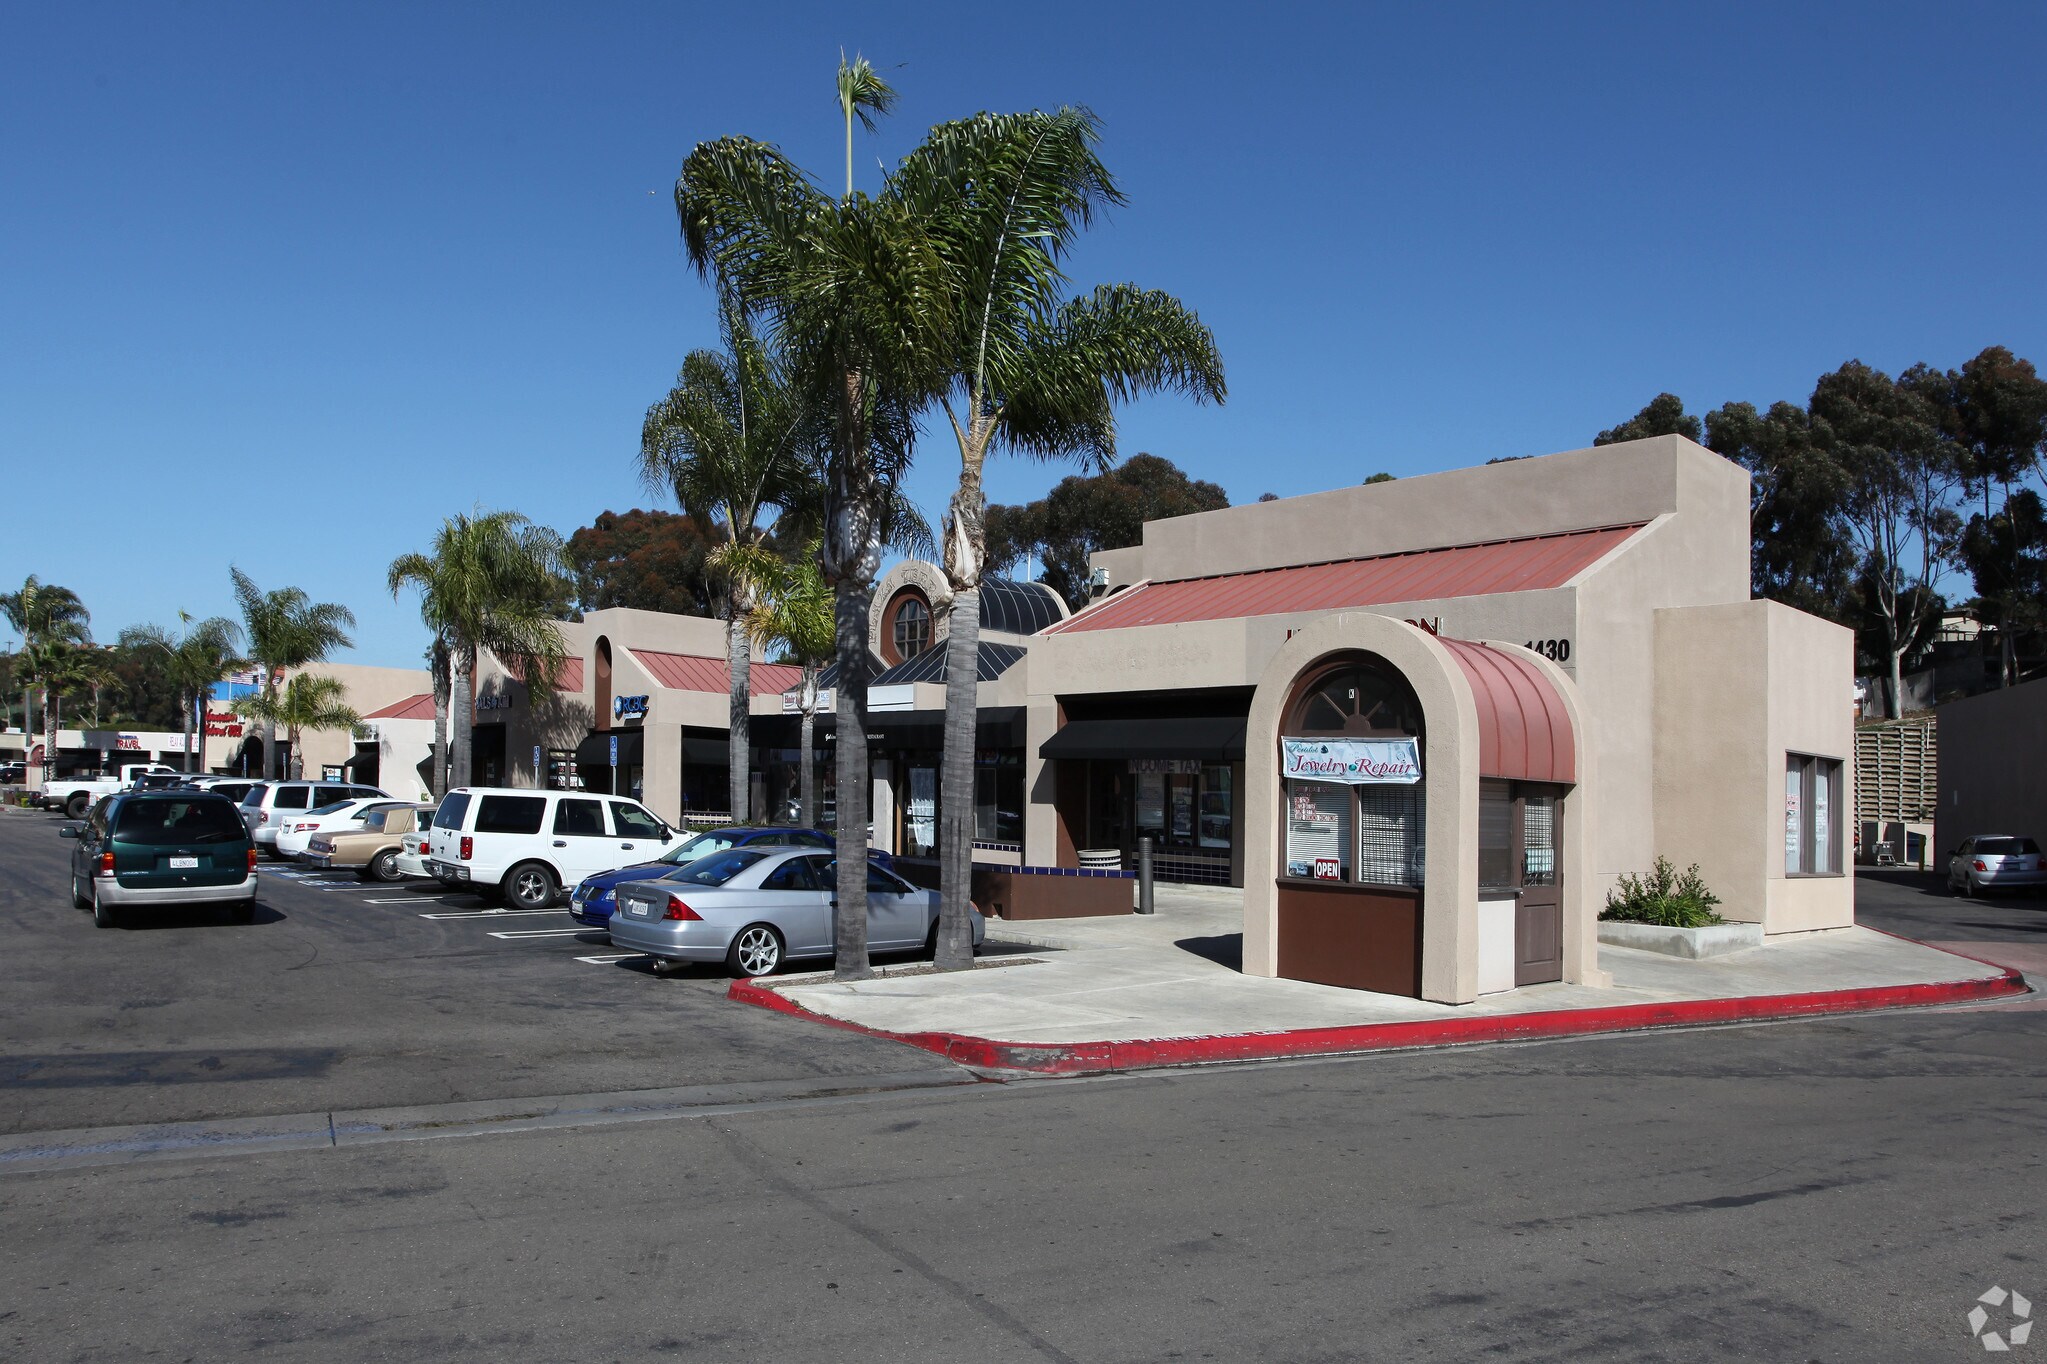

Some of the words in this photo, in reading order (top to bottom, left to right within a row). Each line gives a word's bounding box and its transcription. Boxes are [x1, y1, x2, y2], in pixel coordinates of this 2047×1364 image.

[623, 696, 646, 711] RCBC
[115, 740, 141, 749] TRAVEL
[1128, 759, 1174, 772] INCOME
[1180, 759, 1201, 773] TAX
[1290, 755, 1348, 775] Jewelry
[1355, 758, 1414, 779] Repair
[1316, 862, 1338, 877] OPEN
